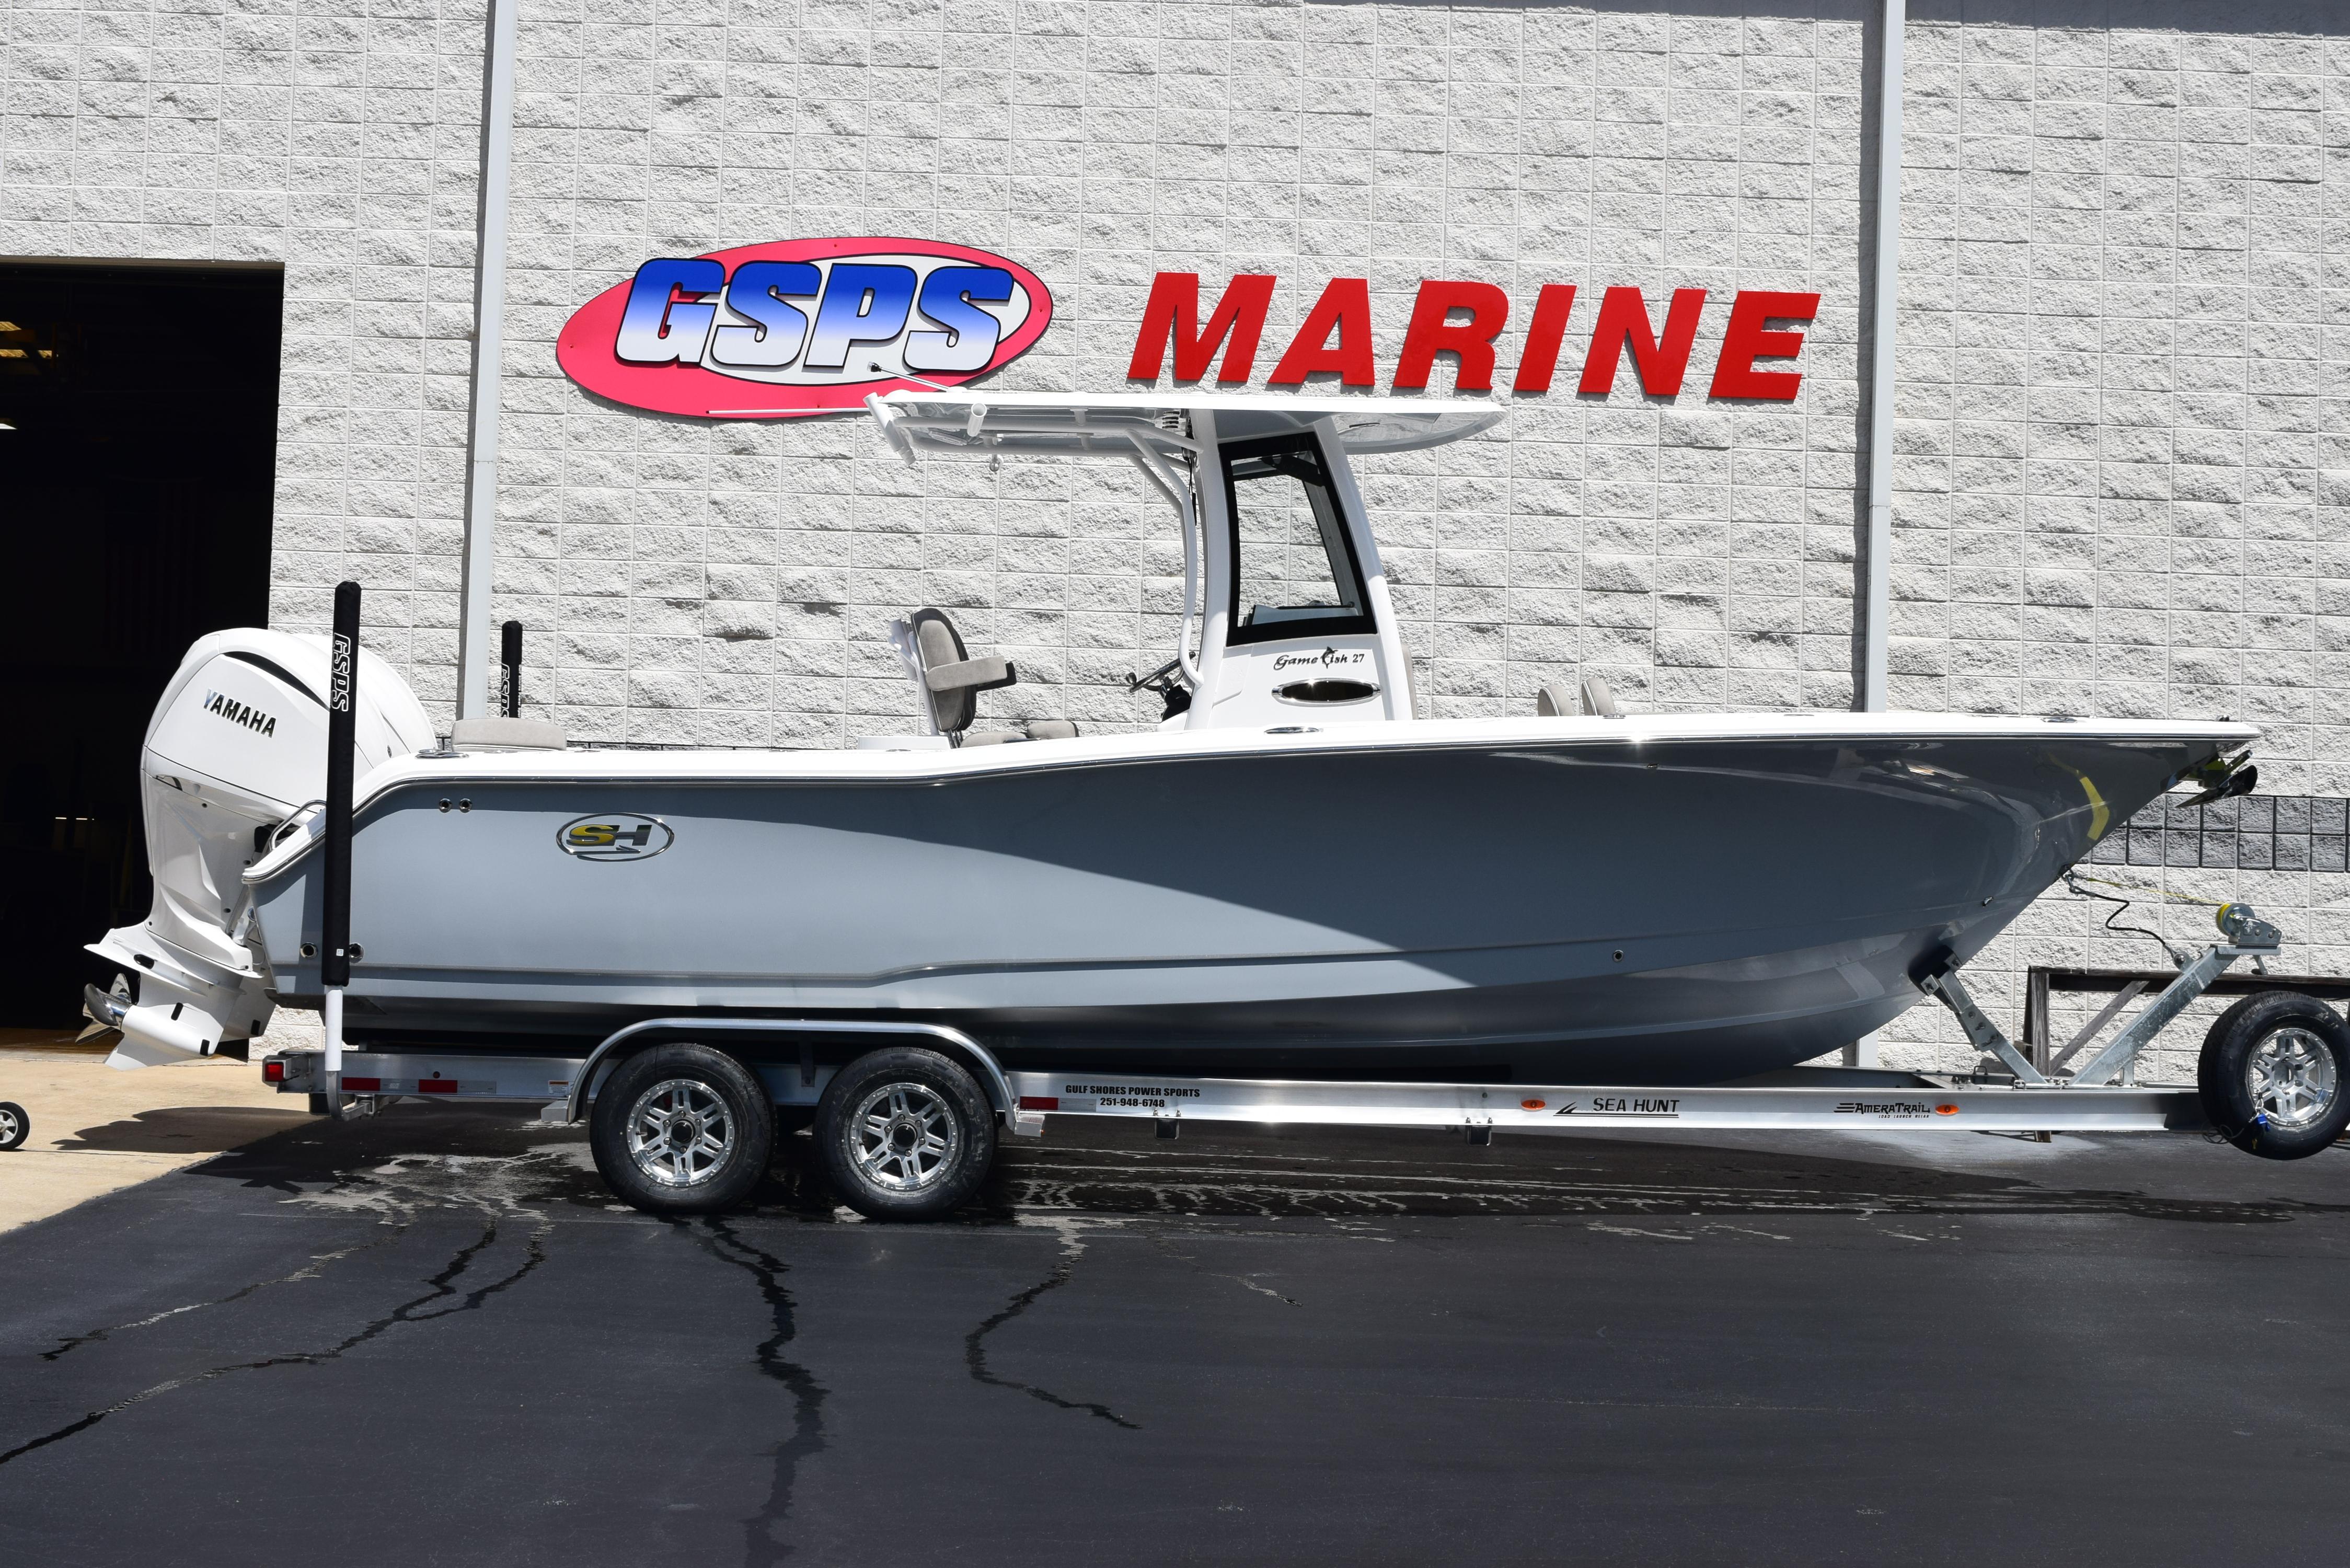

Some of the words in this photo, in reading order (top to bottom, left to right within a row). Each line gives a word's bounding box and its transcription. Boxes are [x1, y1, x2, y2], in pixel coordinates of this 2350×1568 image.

[615, 257, 1015, 372] GSPS
[1127, 272, 1822, 400] MARINE
[330, 632, 351, 712] GSPS
[1273, 654, 1317, 671] Game
[1353, 654, 1365, 663] 27
[203, 689, 276, 738] YAMAHA
[566, 824, 652, 846] SH
[1066, 1085, 1088, 1094] GULF
[1090, 1086, 1126, 1095] SHORES
[1128, 1087, 1161, 1096] POWER
[1164, 1088, 1200, 1097] SPORTS
[1100, 1098, 1165, 1108] 251-948-6748
[1593, 1098, 1626, 1112] SEA
[1633, 1099, 1680, 1112] HUNT
